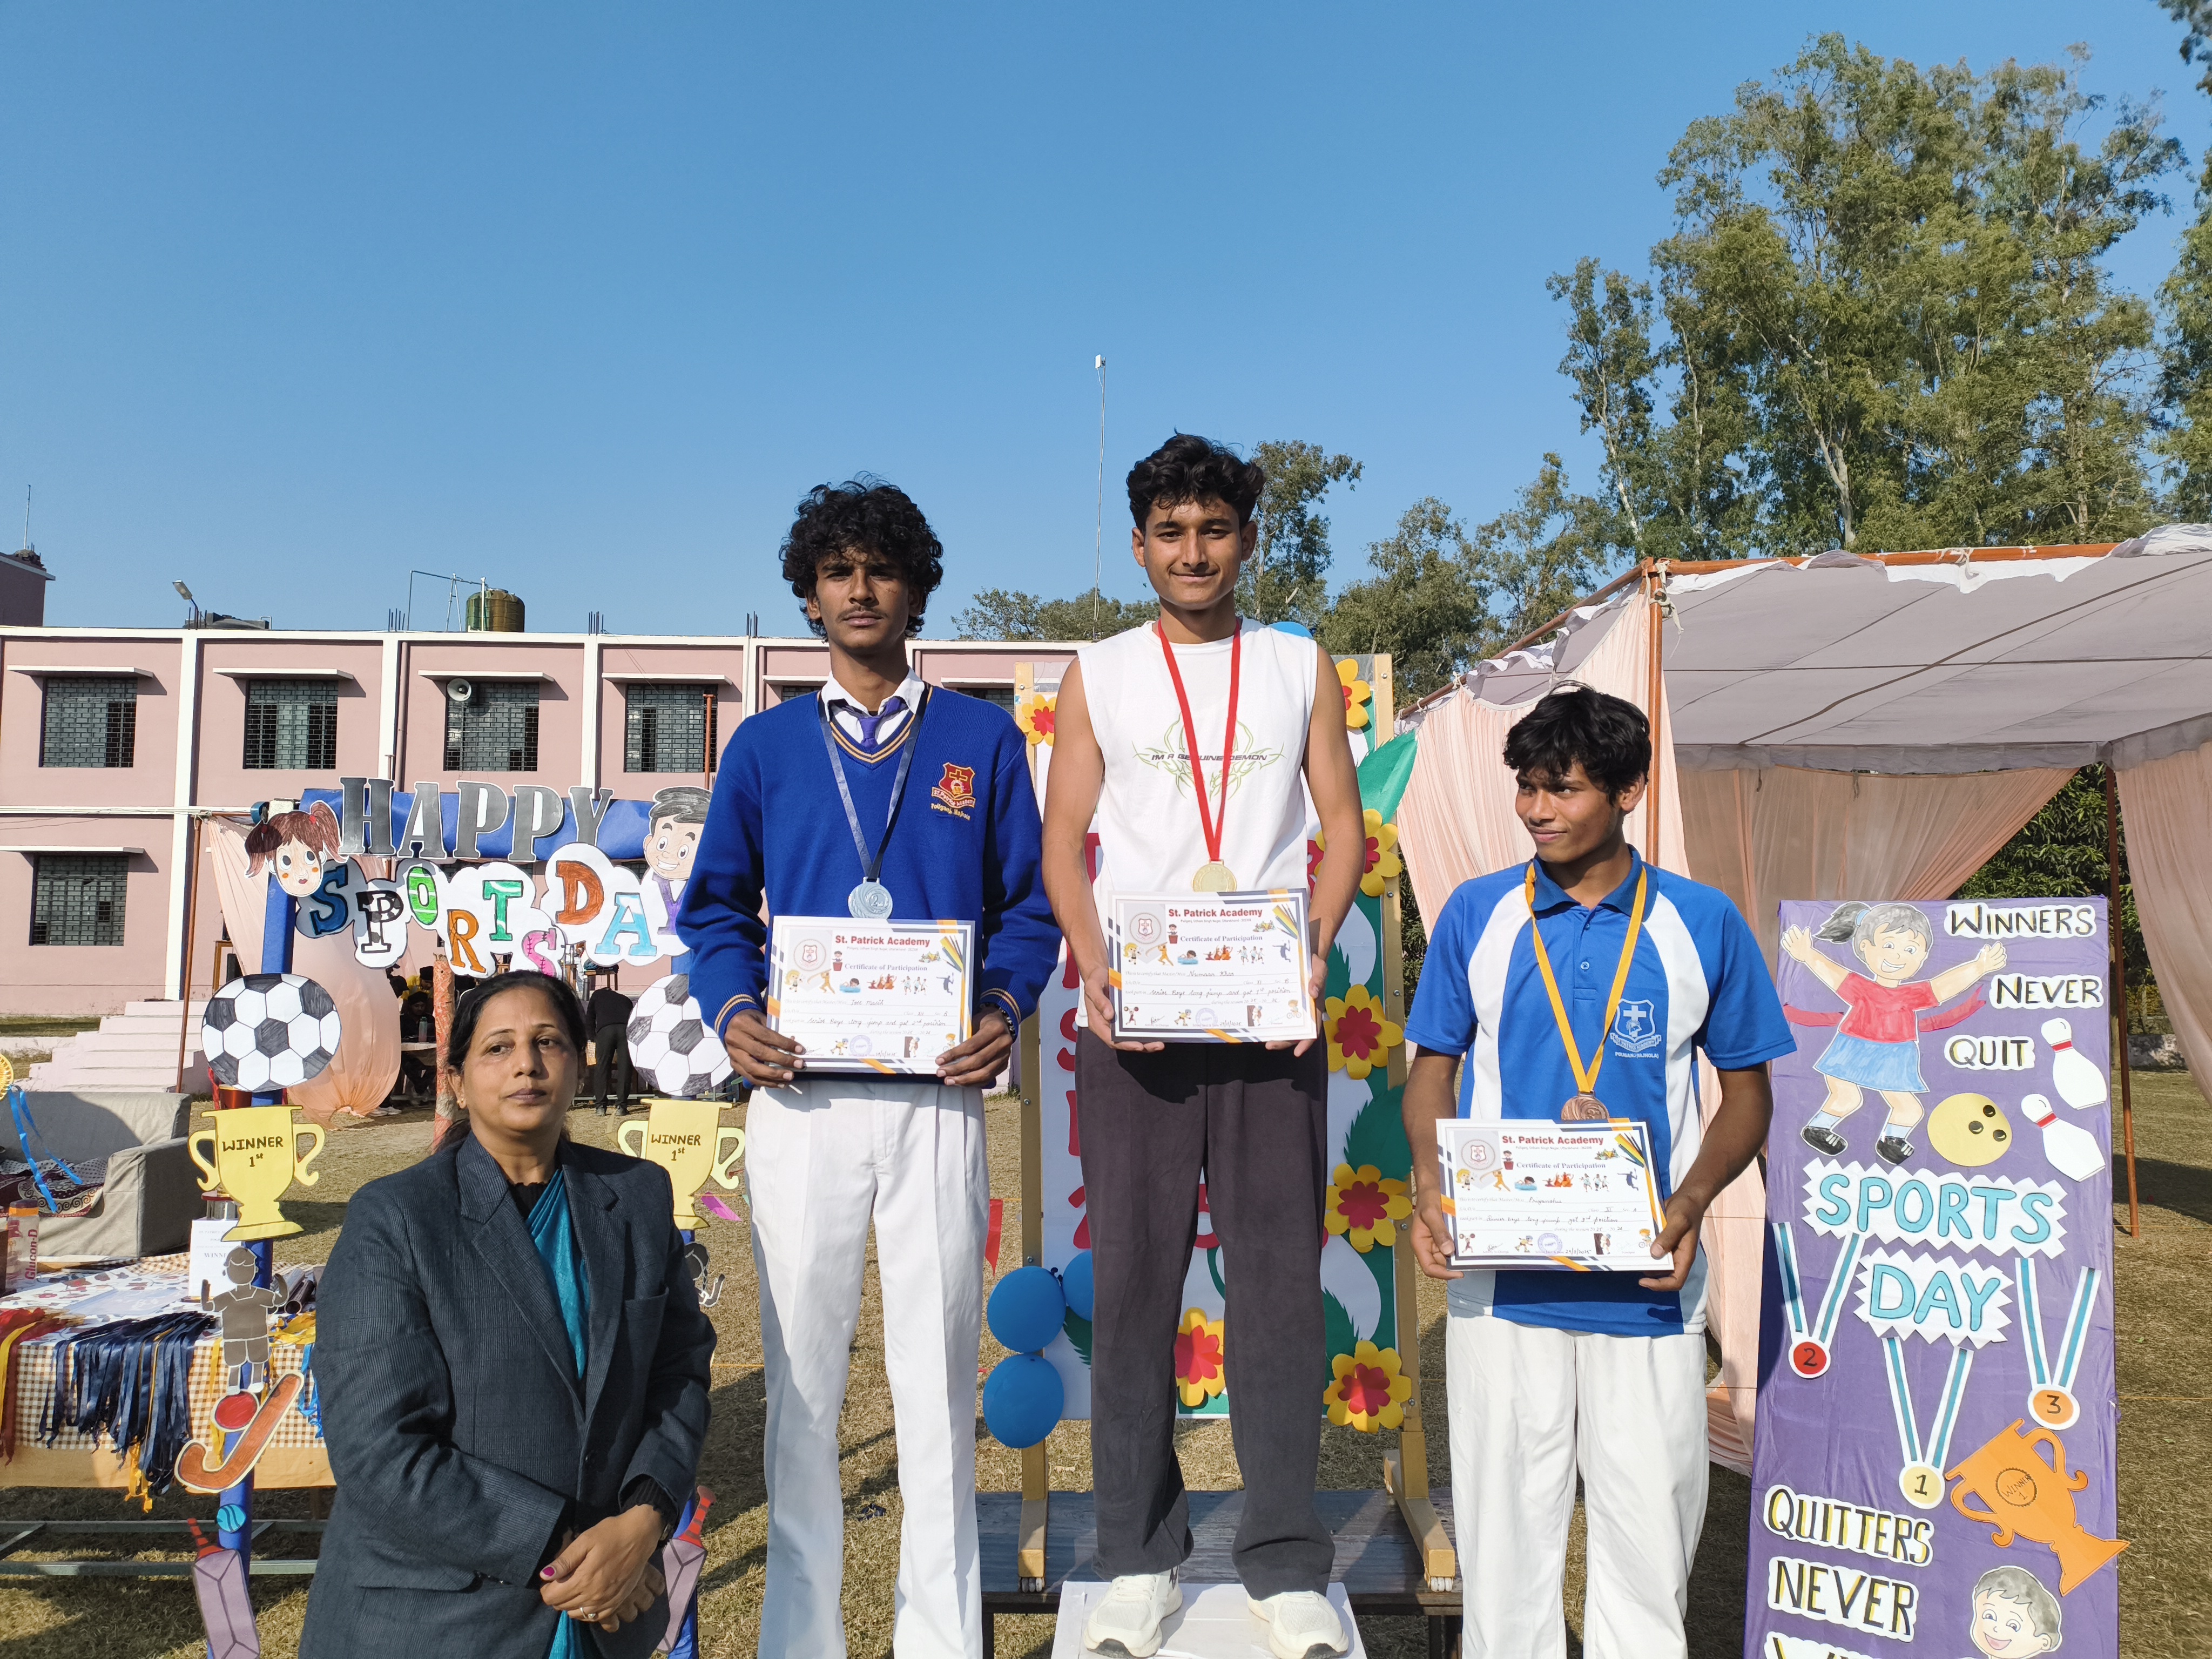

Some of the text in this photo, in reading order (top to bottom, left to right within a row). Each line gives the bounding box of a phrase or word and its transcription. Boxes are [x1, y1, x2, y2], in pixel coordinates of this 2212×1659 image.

[340, 777, 613, 862] HAPPY
[309, 860, 687, 976] SPORTS DAY
[1169, 908, 1263, 918] St. Patrick Academy
[1950, 905, 2095, 936] WINNERS
[835, 935, 930, 947] St. Patrick Academy
[1223, 935, 1263, 943] Participation
[1996, 975, 2102, 1004] NEVER
[1948, 1039, 2029, 1068] QUIT
[222, 1135, 284, 1151] WINNER
[651, 1132, 701, 1147] WINNER
[1502, 1136, 1515, 1144] St.
[1557, 1136, 1603, 1145] Academy
[249, 1152, 264, 1168] 1st
[671, 1147, 685, 1162] 1st
[1816, 1173, 2054, 1245] SPORTS
[25, 1229, 38, 1280] Glucon-D
[1869, 1263, 2000, 1331] DAY
[1803, 1348, 1818, 1367] 2
[2047, 1394, 2061, 1414] 3
[1915, 1474, 1928, 1495] 1
[2001, 1473, 2031, 1497] WINNER
[2019, 1491, 2028, 1500] 1
[1768, 1488, 1933, 1564] QUITTERS
[1773, 1560, 1915, 1636] NEVER
